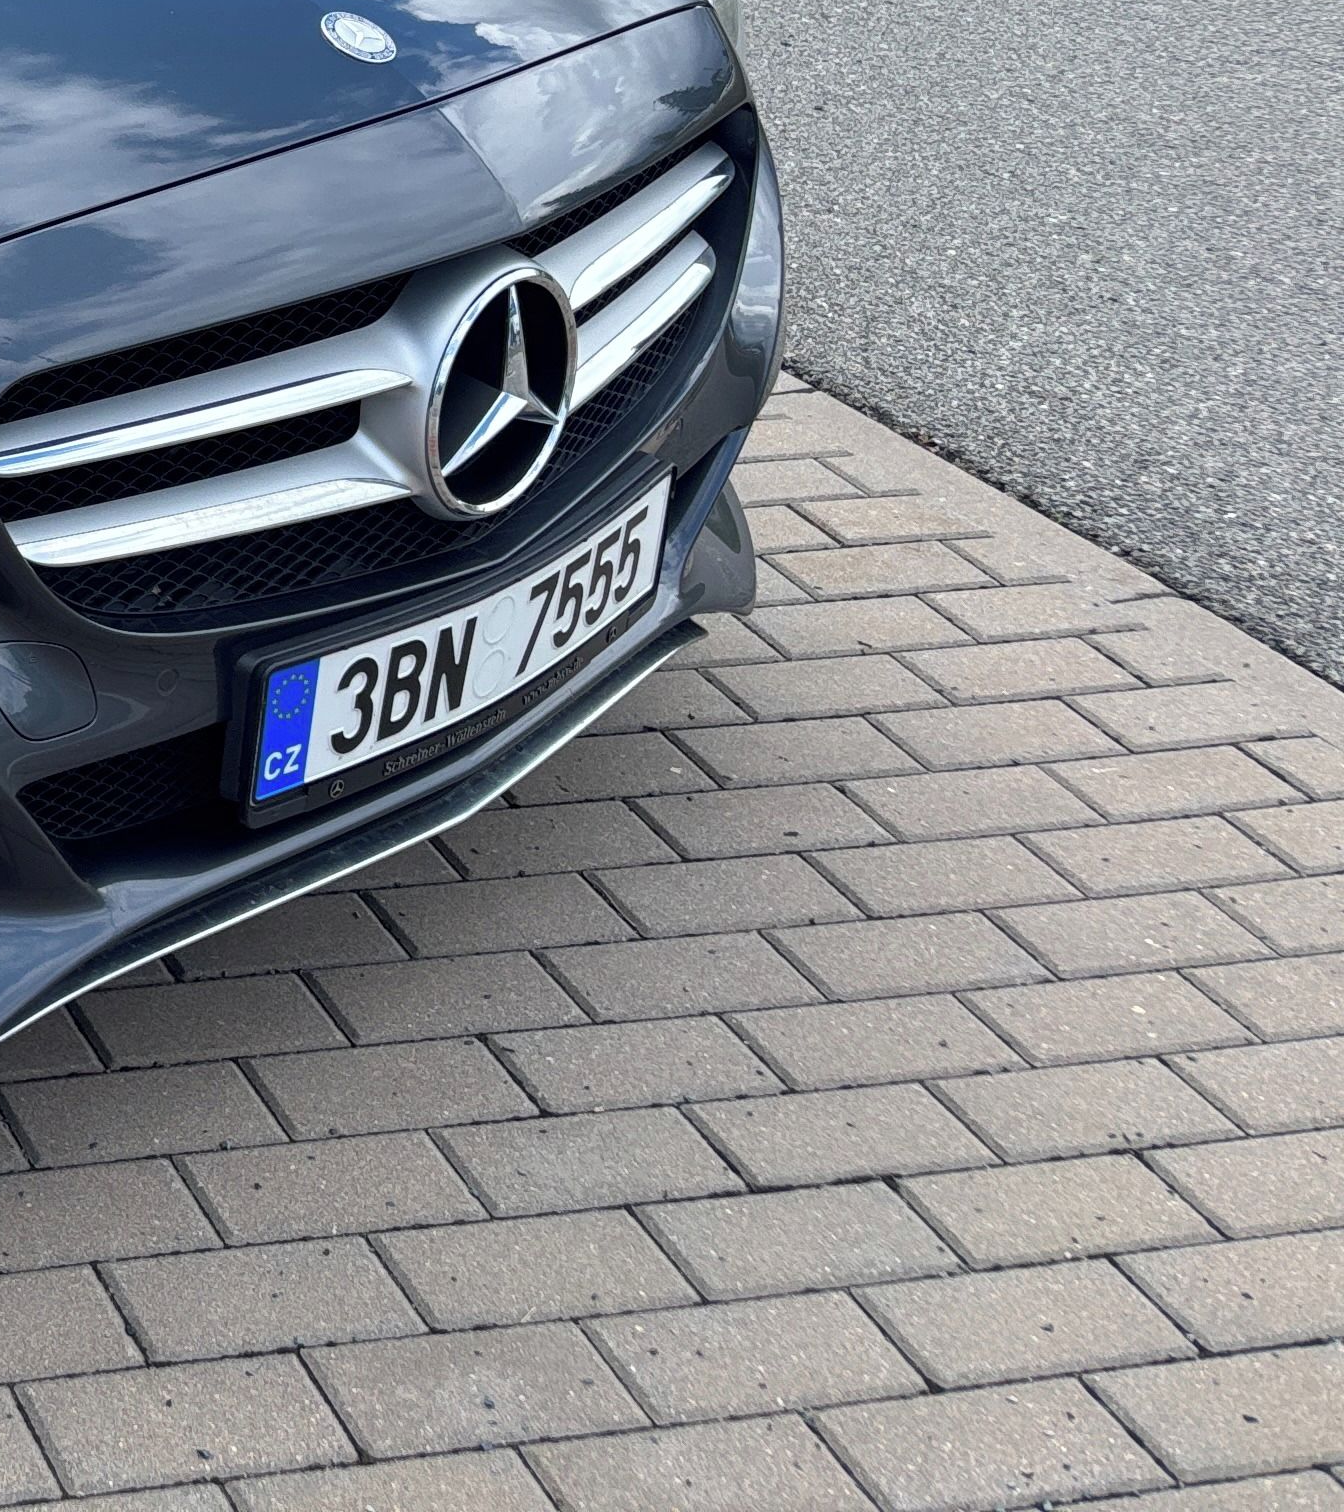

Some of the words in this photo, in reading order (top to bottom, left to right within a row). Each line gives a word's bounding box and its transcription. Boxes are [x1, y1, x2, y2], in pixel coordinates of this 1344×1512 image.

[328, 616, 478, 756] 3BN
[514, 506, 649, 676] 7555
[263, 742, 302, 783] CZ
